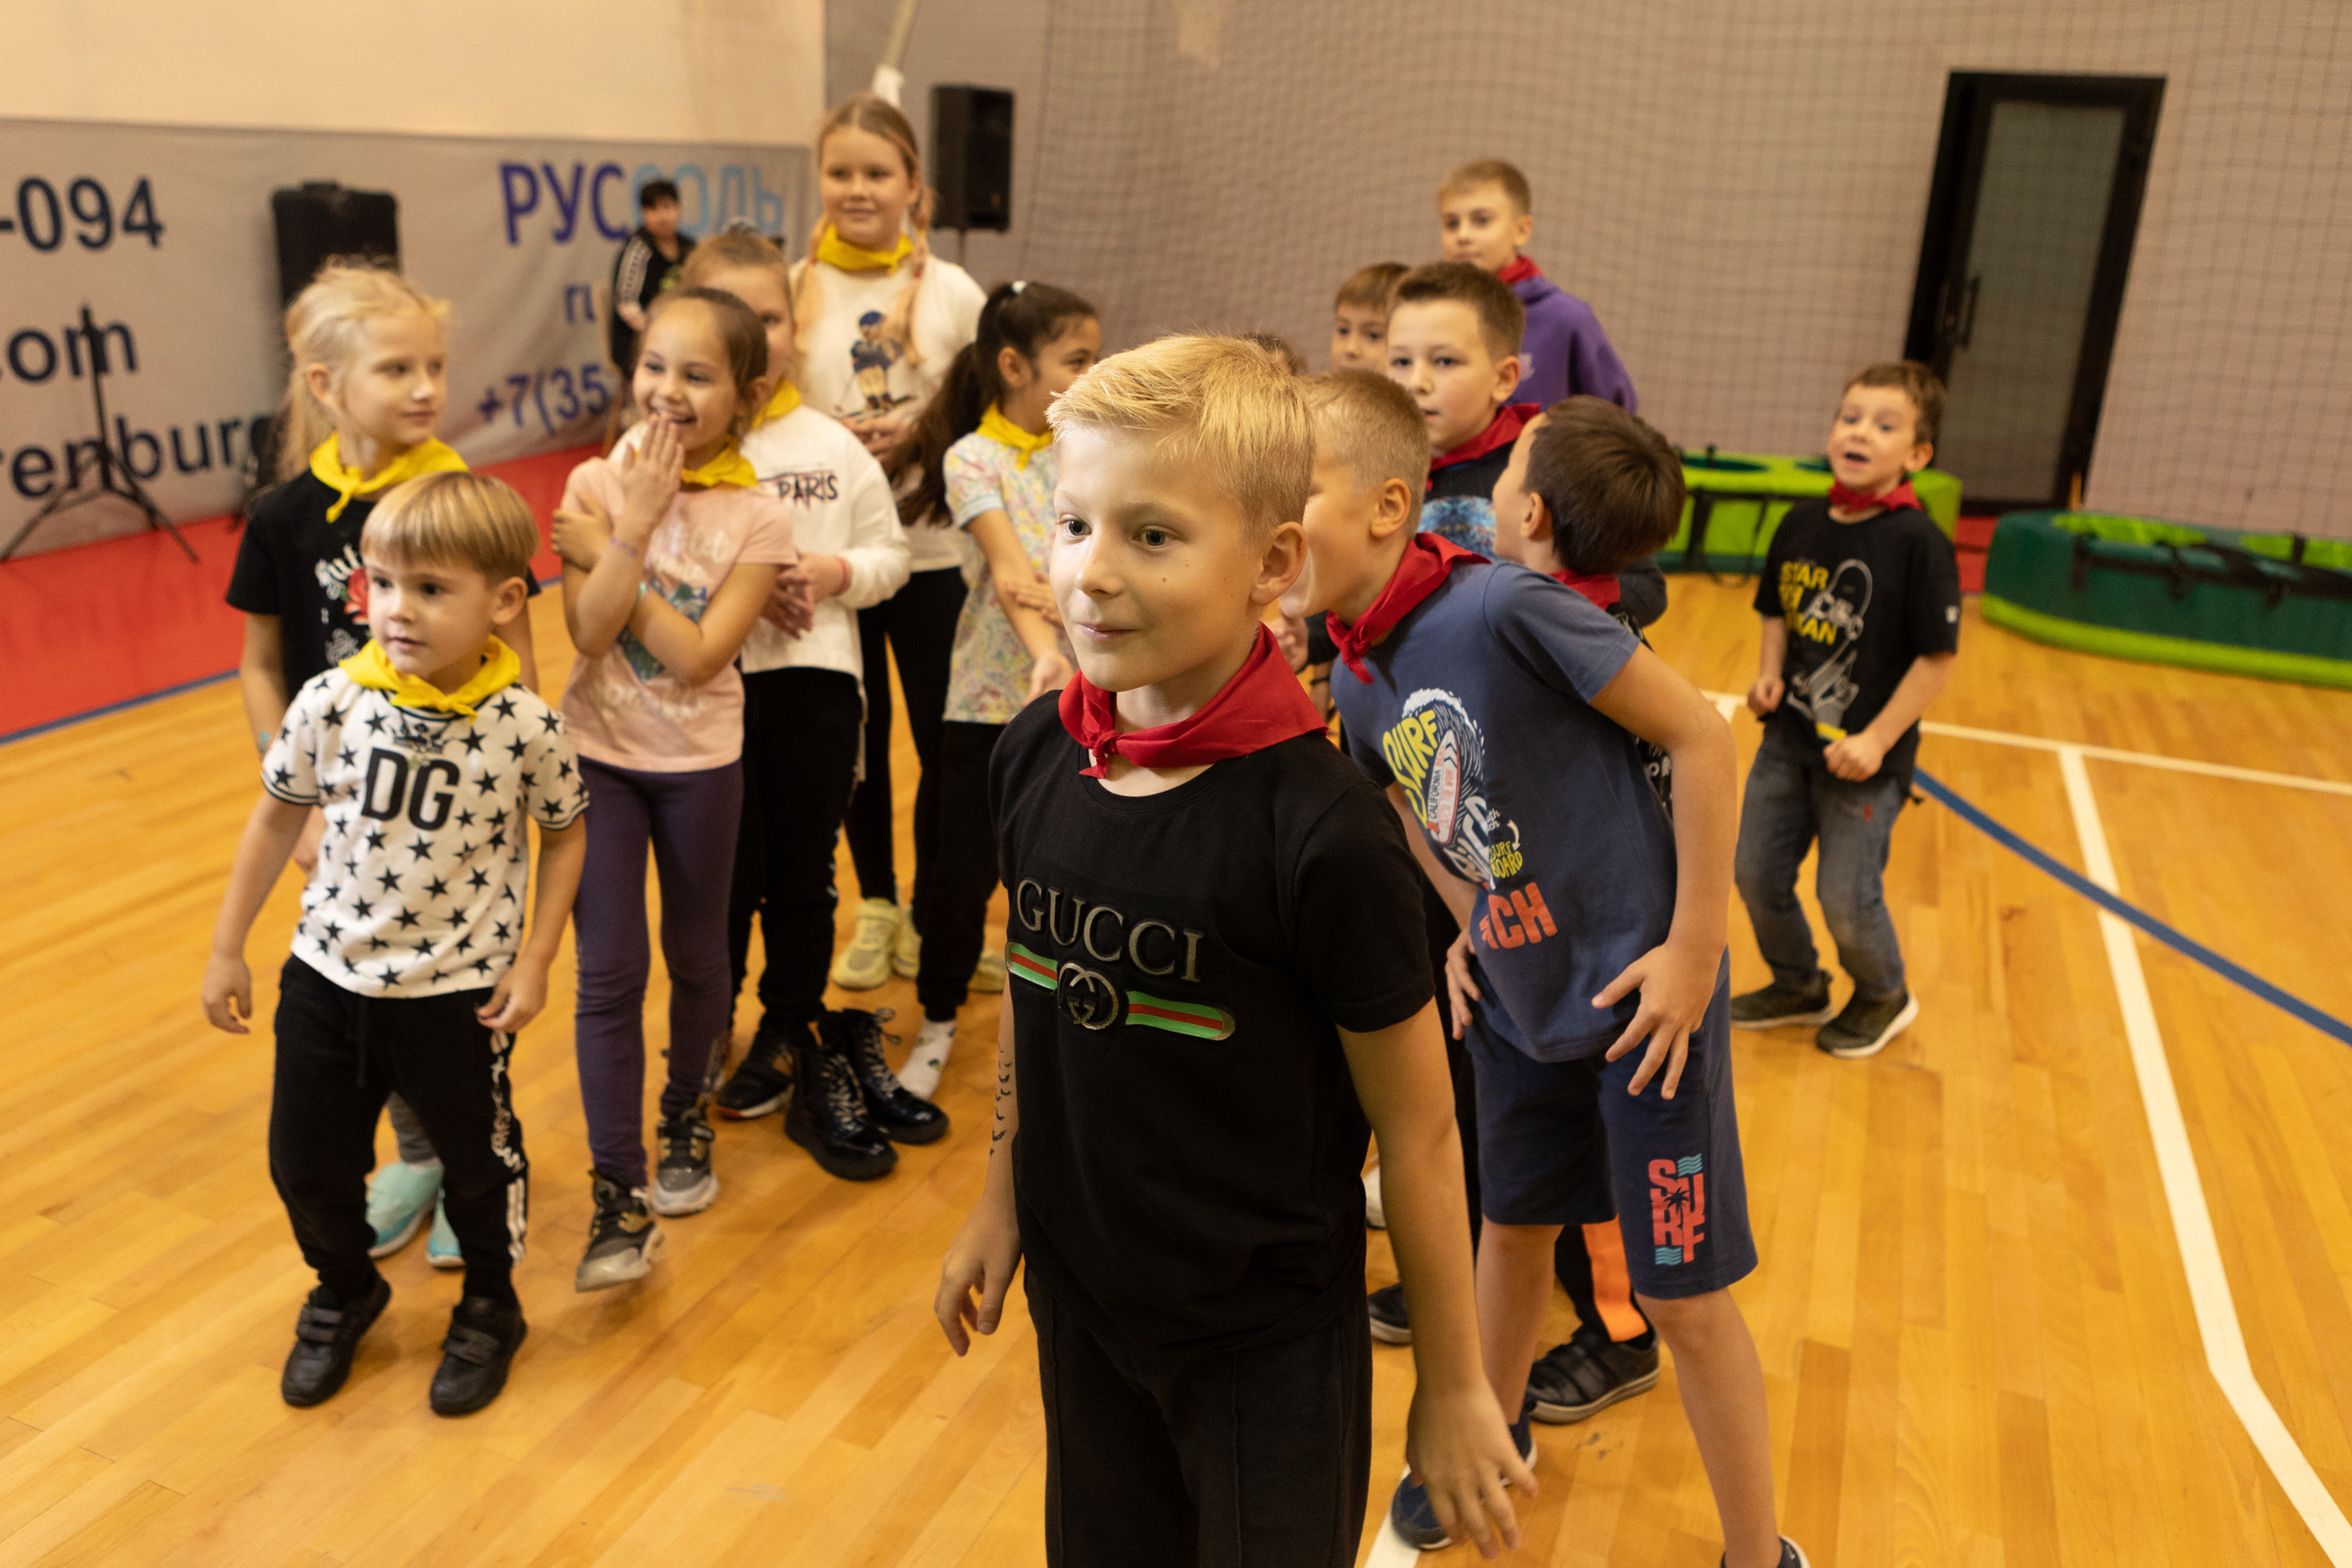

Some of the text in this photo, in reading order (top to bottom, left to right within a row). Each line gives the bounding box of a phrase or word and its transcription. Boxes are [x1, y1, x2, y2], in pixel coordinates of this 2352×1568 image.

[777, 474, 838, 509] PARIS
[360, 747, 459, 831] DG
[1383, 709, 1439, 829] SURF
[1428, 769, 1442, 820] CALIFORNIA
[1016, 879, 1204, 983] GUCCI
